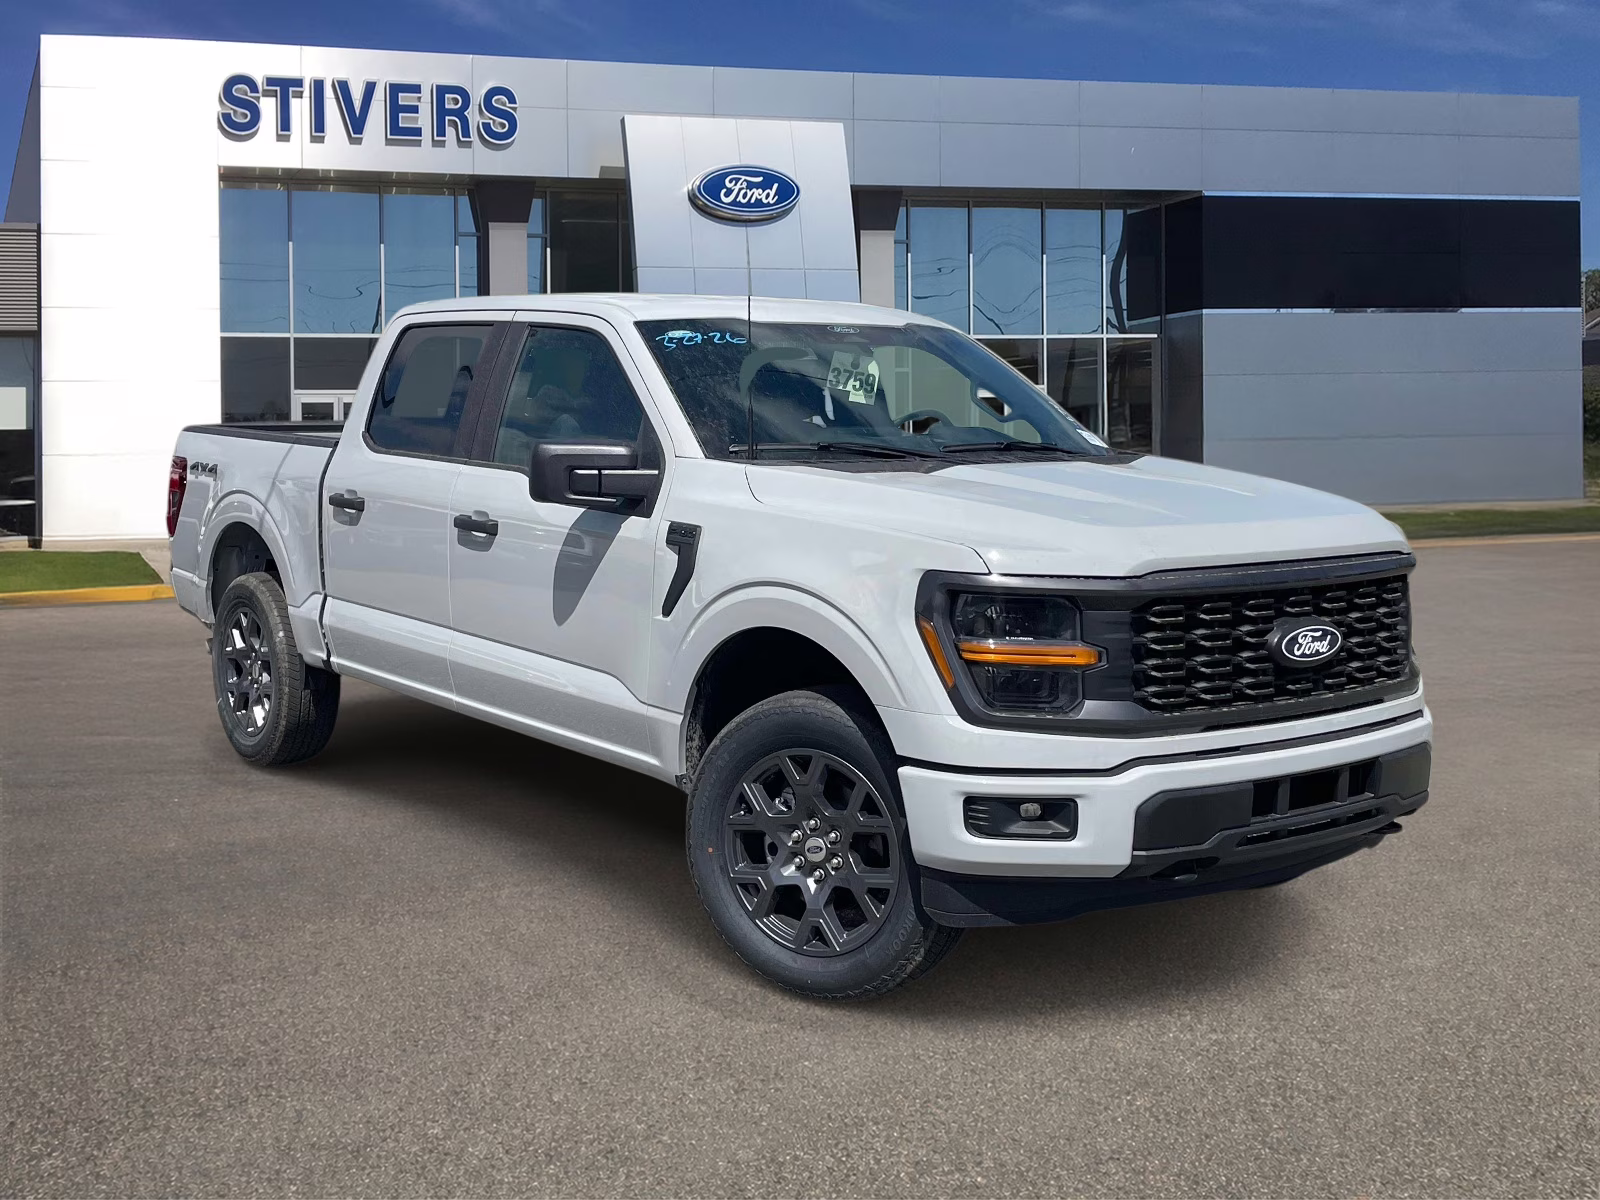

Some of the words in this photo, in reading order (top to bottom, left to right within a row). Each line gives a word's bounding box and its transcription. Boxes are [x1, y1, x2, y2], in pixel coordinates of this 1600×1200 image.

[218, 73, 519, 145] STIVERS
[720, 174, 779, 204] Ford
[828, 366, 877, 395] 3759
[1293, 630, 1331, 656] Ford
